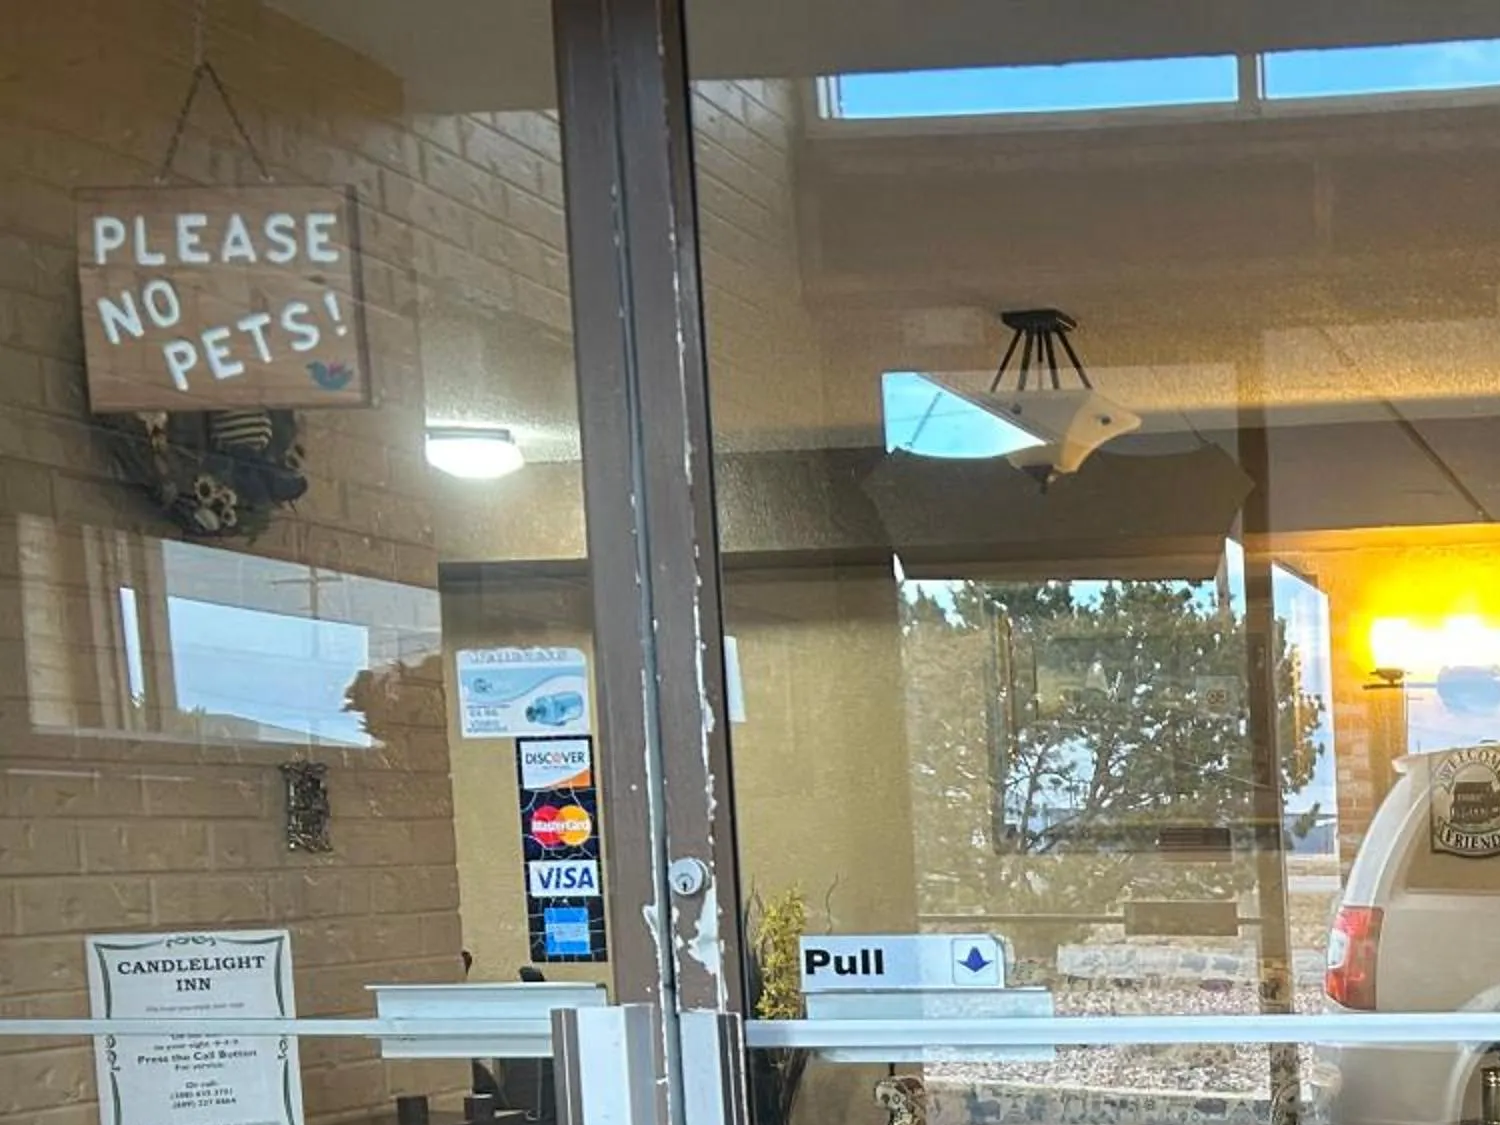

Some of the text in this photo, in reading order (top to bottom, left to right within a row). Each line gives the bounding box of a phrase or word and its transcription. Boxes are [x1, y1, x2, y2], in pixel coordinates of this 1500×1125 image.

[94, 213, 339, 266] PLEASE
[97, 280, 180, 344] NO
[163, 292, 347, 391] PETS!
[525, 751, 586, 765] DISCOVER
[538, 866, 595, 890] VISA
[117, 955, 266, 976] CANDLELIGHT
[803, 948, 885, 976] Pull
[176, 977, 212, 992] INN
[137, 1055, 168, 1064] Press
[171, 1053, 190, 1062] the
[193, 1050, 215, 1061] Call
